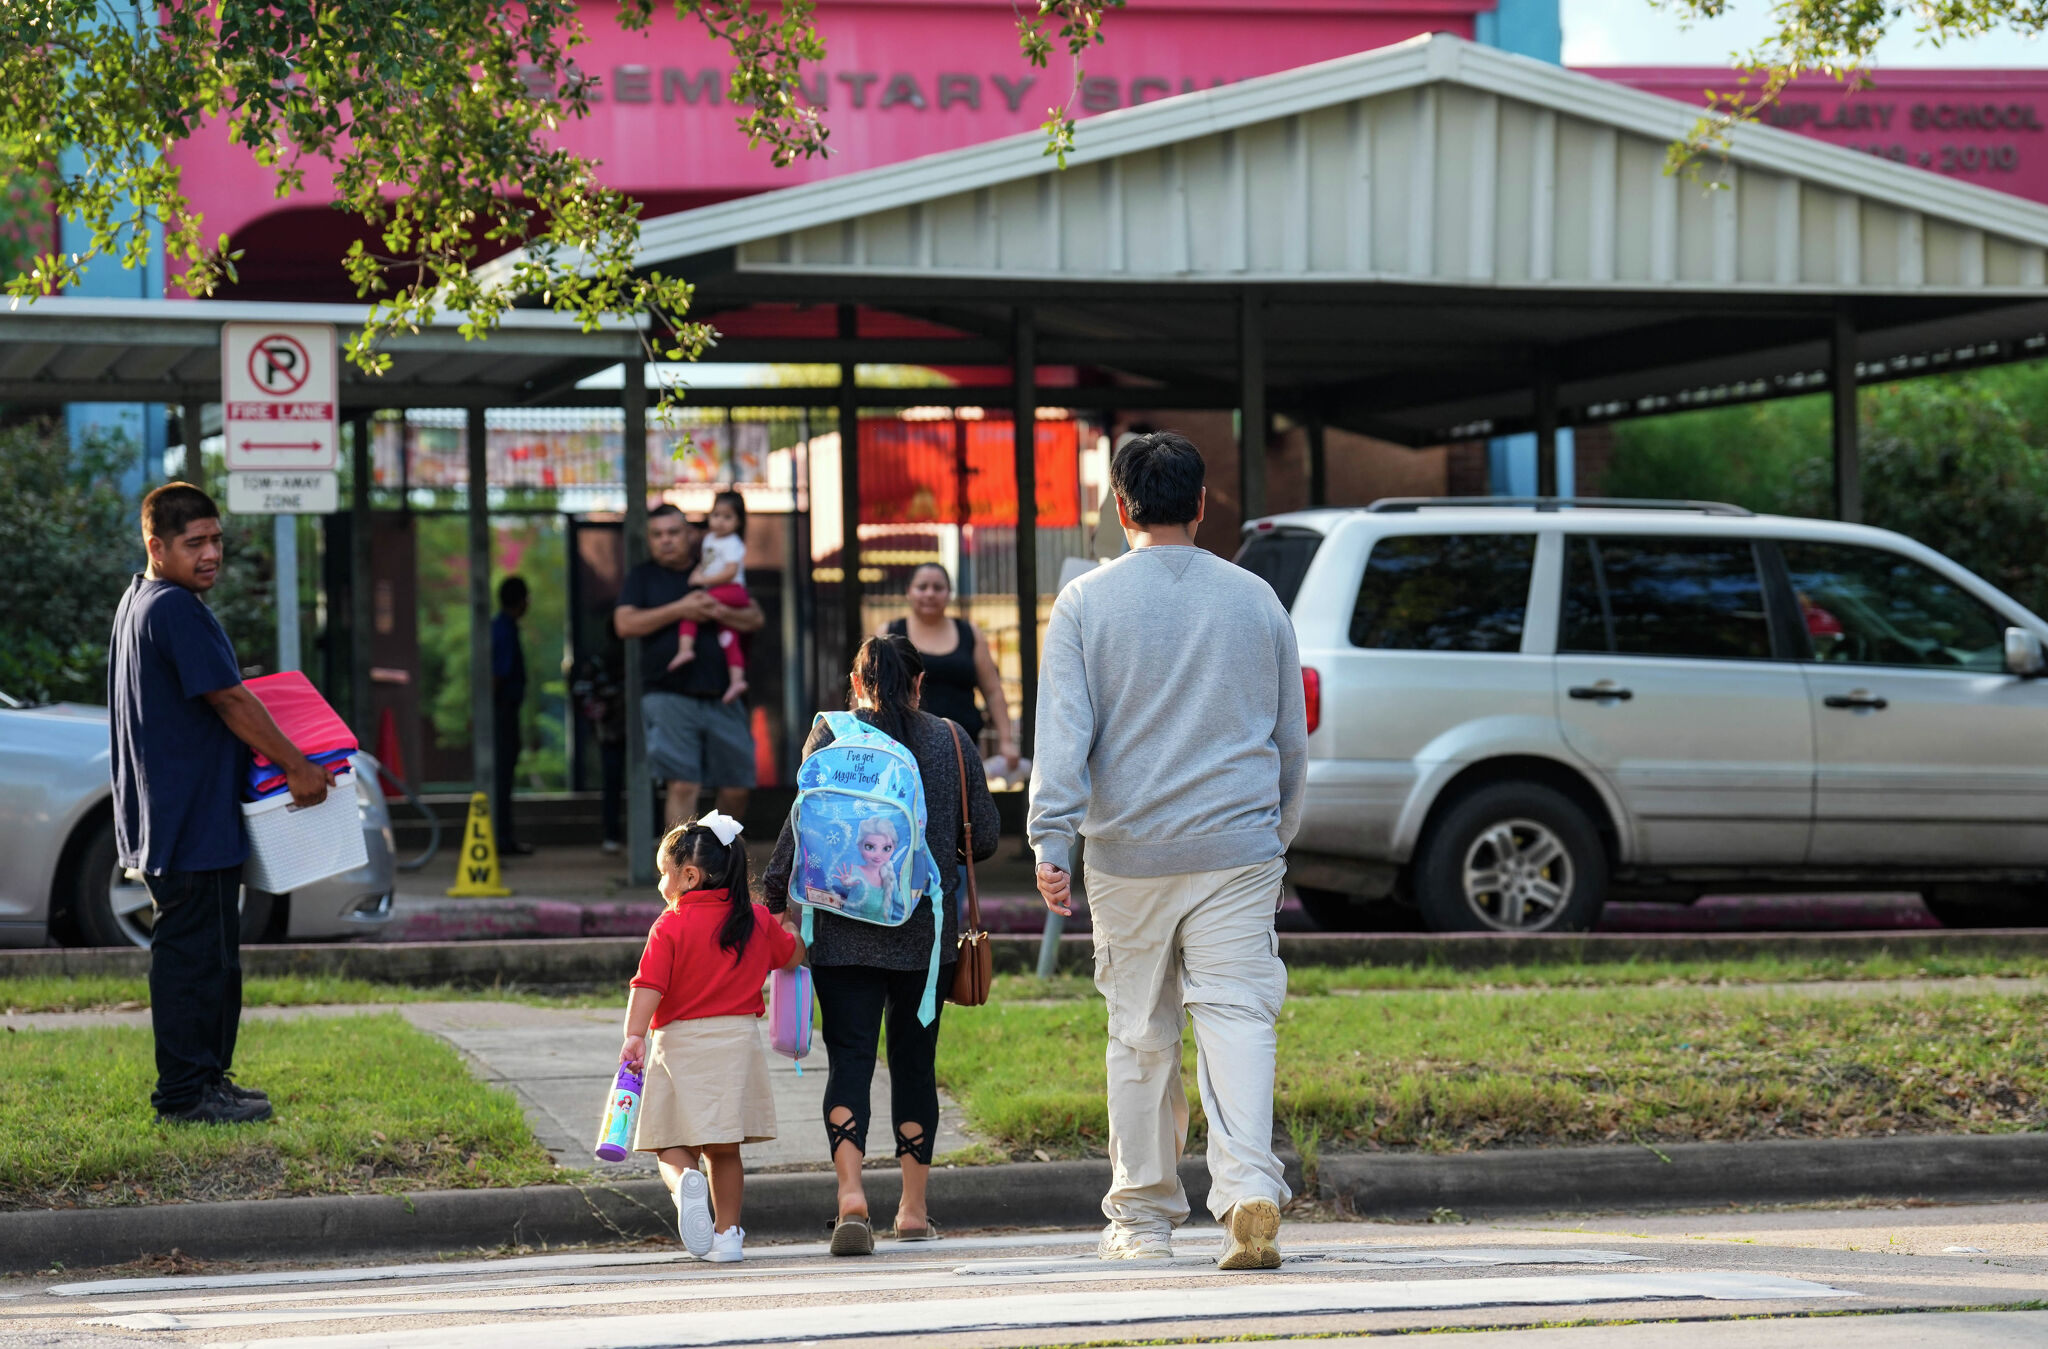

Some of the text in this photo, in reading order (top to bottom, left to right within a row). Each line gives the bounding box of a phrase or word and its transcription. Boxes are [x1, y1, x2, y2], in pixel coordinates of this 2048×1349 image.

[1910, 103, 2044, 130] SCHOOL
[1940, 144, 2019, 172] 2010
[231, 404, 327, 420] FIRE LANE
[242, 476, 322, 490] TOW-AWAY
[263, 494, 303, 509] ZONE
[846, 750, 874, 766] I've got
[854, 762, 865, 772] the
[831, 769, 880, 785] Magic Touch
[467, 800, 491, 884] SLOW
